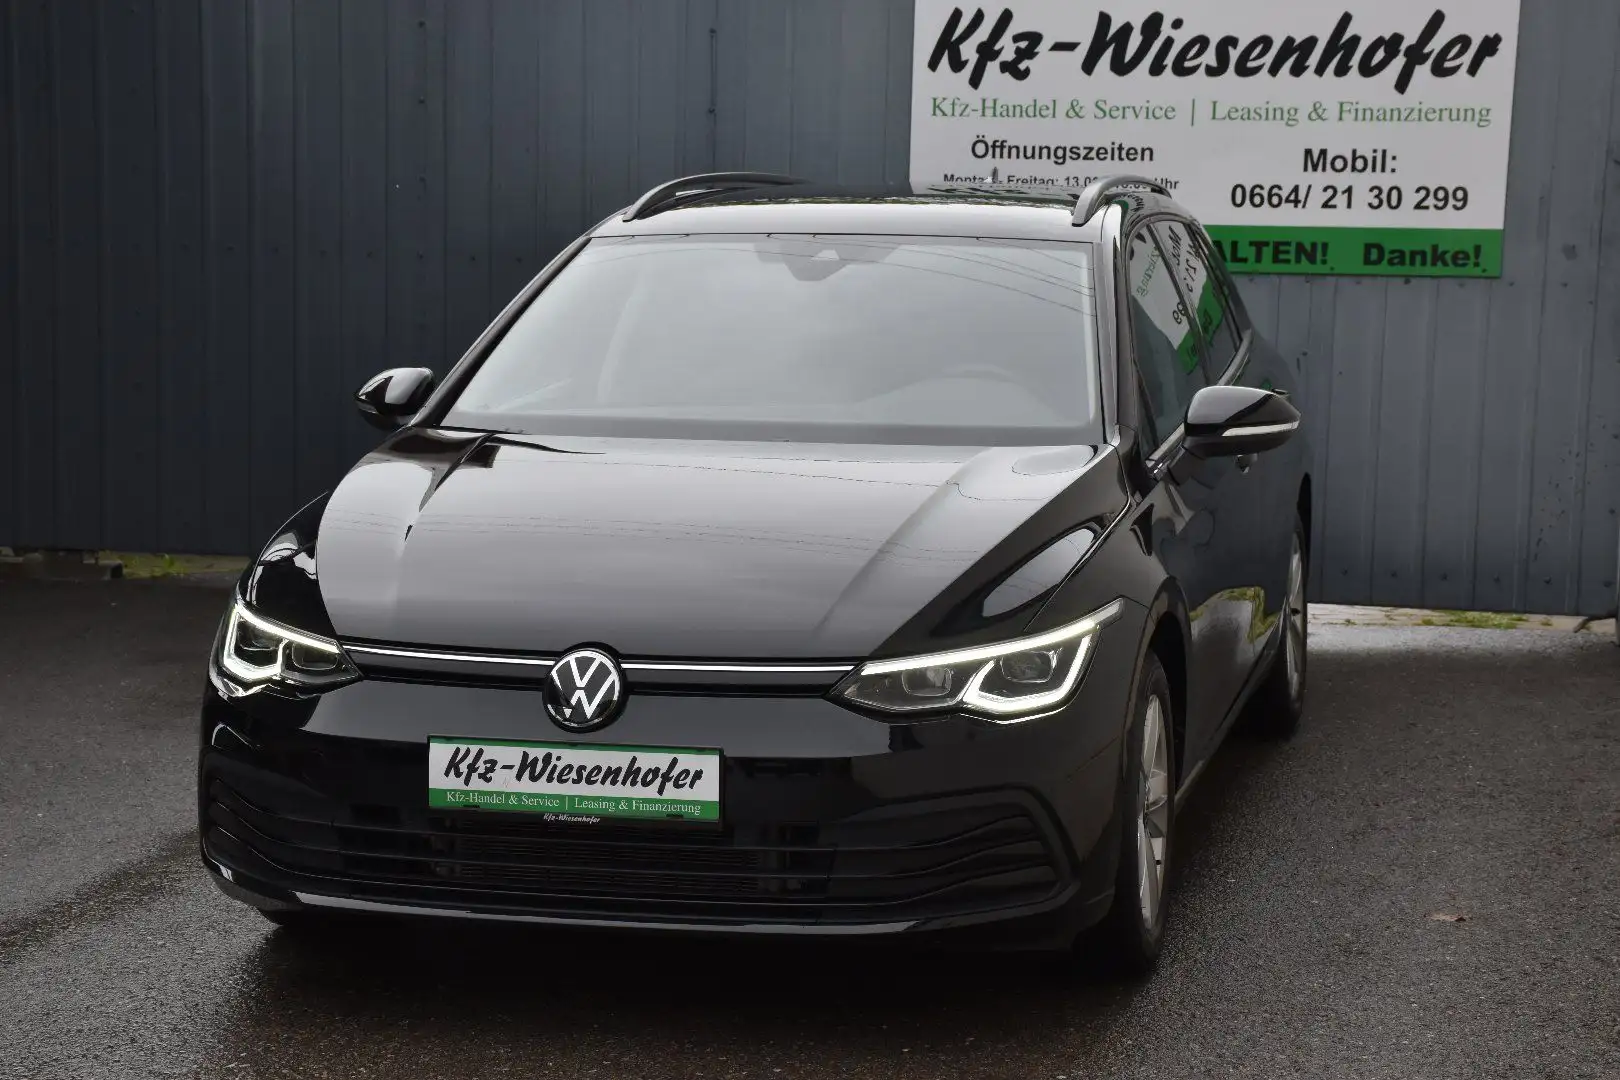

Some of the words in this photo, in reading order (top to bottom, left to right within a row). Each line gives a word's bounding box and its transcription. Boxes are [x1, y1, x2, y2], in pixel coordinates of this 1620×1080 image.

[927, 6, 1502, 95] Kfz-Wiesenhofer
[931, 97, 1057, 119] Kfz-Handel
[1065, 100, 1085, 120] &
[1094, 98, 1176, 121] Service
[1211, 101, 1300, 126] Leasing
[1308, 102, 1328, 123] &
[1338, 101, 1492, 127] Finanzierung
[971, 135, 1154, 165] Öffnungszeiten
[1303, 147, 1397, 174] Mobil:
[943, 173, 998, 184] Monta
[1230, 183, 1313, 210] 0664/
[1320, 184, 1353, 210] 21
[1367, 185, 1403, 210] 30
[1413, 185, 1469, 211] 299
[1363, 242, 1482, 268] Danke!
[443, 746, 704, 796] Kfz-Wiesenhofer
[446, 791, 506, 805] Kfz-Handel
[508, 795, 518, 805] &
[521, 794, 560, 807] Service
[574, 797, 615, 812] Leasing
[618, 799, 628, 811] &
[632, 799, 701, 816] Finanzierung
[543, 813, 601, 825] Kfz-Wiesenhofer
